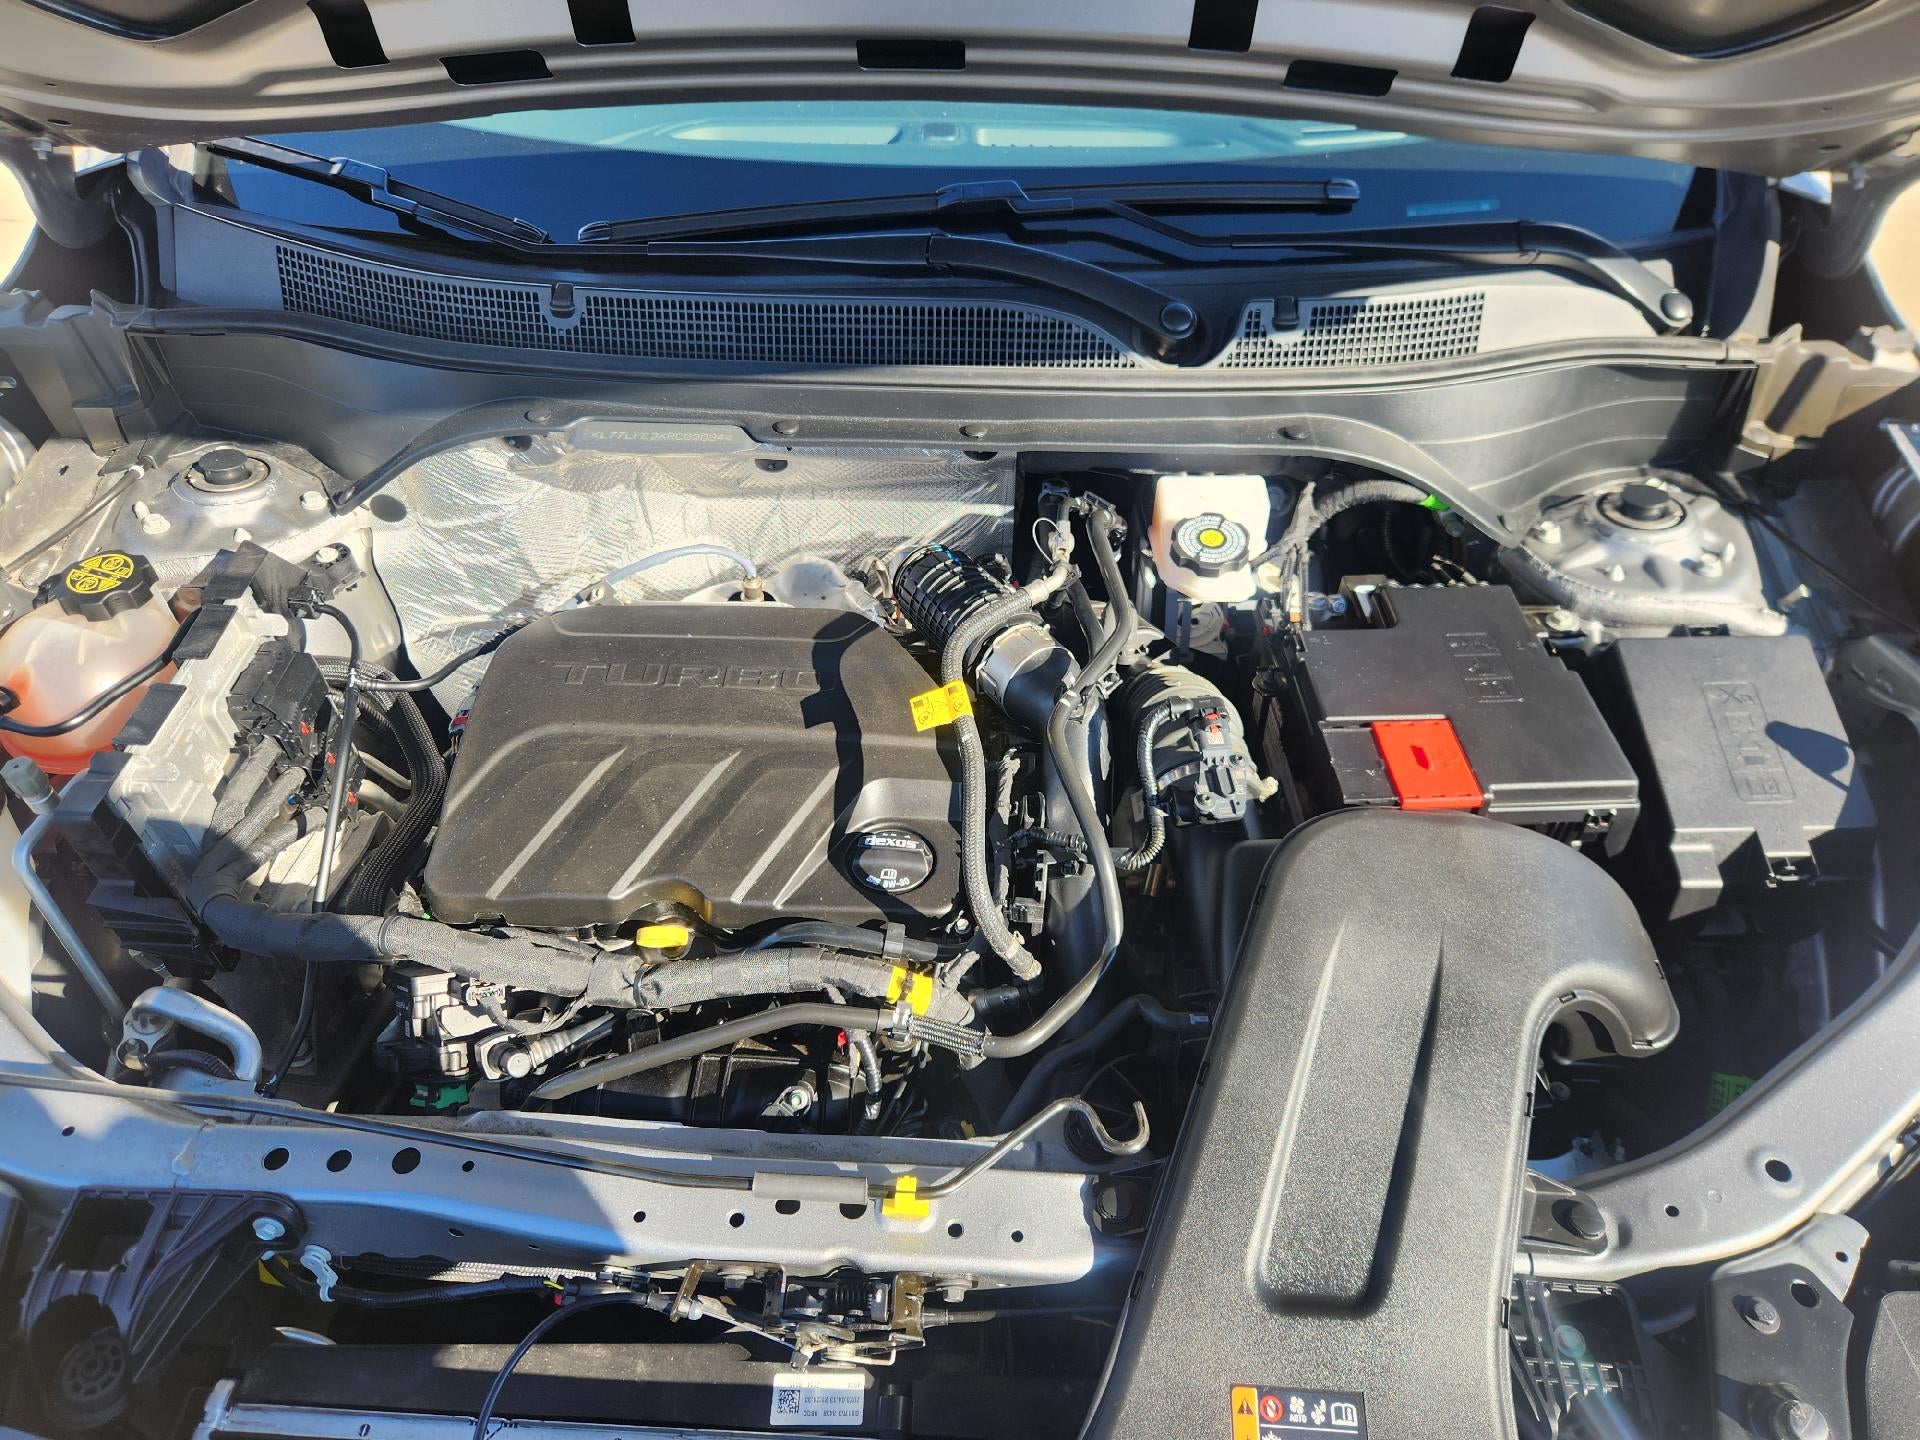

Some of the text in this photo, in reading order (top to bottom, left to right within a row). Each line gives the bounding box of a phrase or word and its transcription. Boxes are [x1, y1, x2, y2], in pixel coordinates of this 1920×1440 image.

[552, 662, 837, 691] TURBO
[864, 835, 919, 849] dexos
[1289, 1414, 1307, 1424] AUTO
